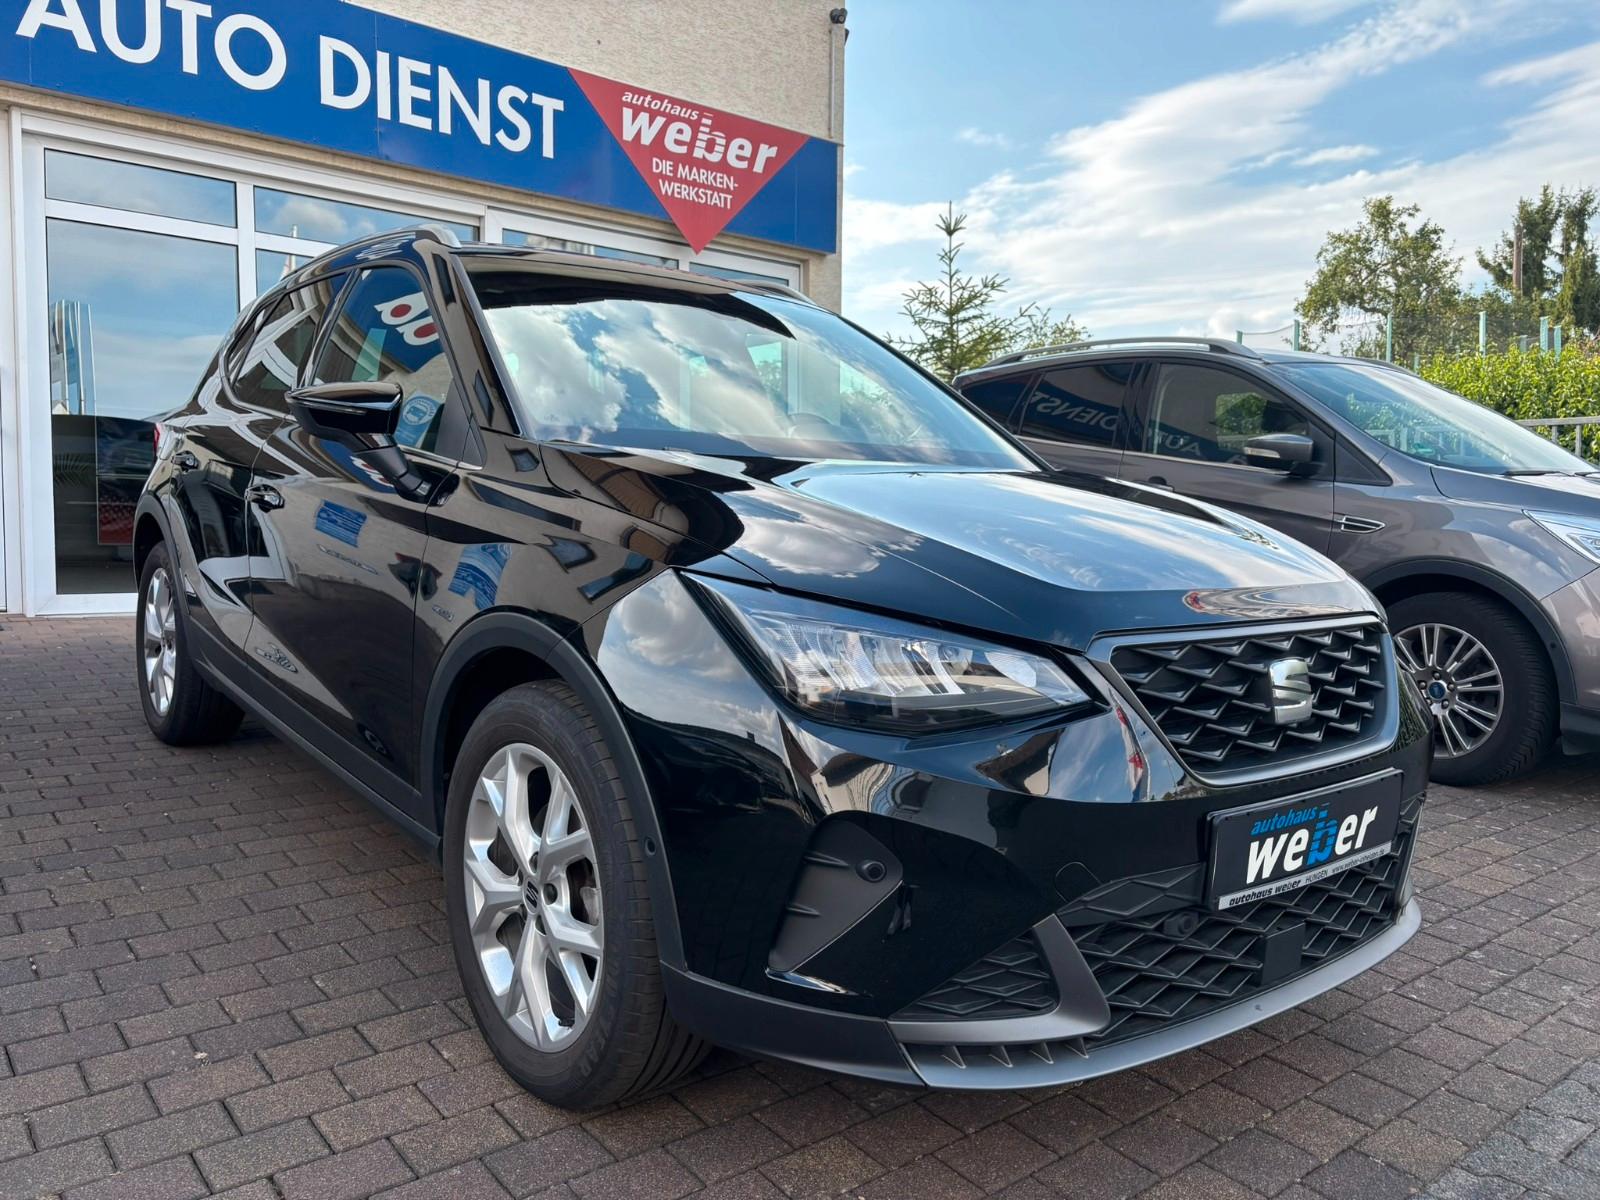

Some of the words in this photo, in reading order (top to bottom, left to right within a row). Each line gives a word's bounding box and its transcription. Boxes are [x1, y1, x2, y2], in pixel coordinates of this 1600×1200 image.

[16, 0, 287, 91] AUTO
[319, 35, 565, 160] DIENST
[621, 91, 700, 120] autohaus
[622, 107, 778, 173] weber
[652, 157, 674, 177] DIE
[676, 164, 739, 191] MARKEN-
[658, 178, 733, 209] WERKSTATT
[1251, 806, 1318, 837] autohaus
[1246, 802, 1379, 885] weber
[1229, 887, 1273, 906] autohaus
[1274, 879, 1302, 893] weber
